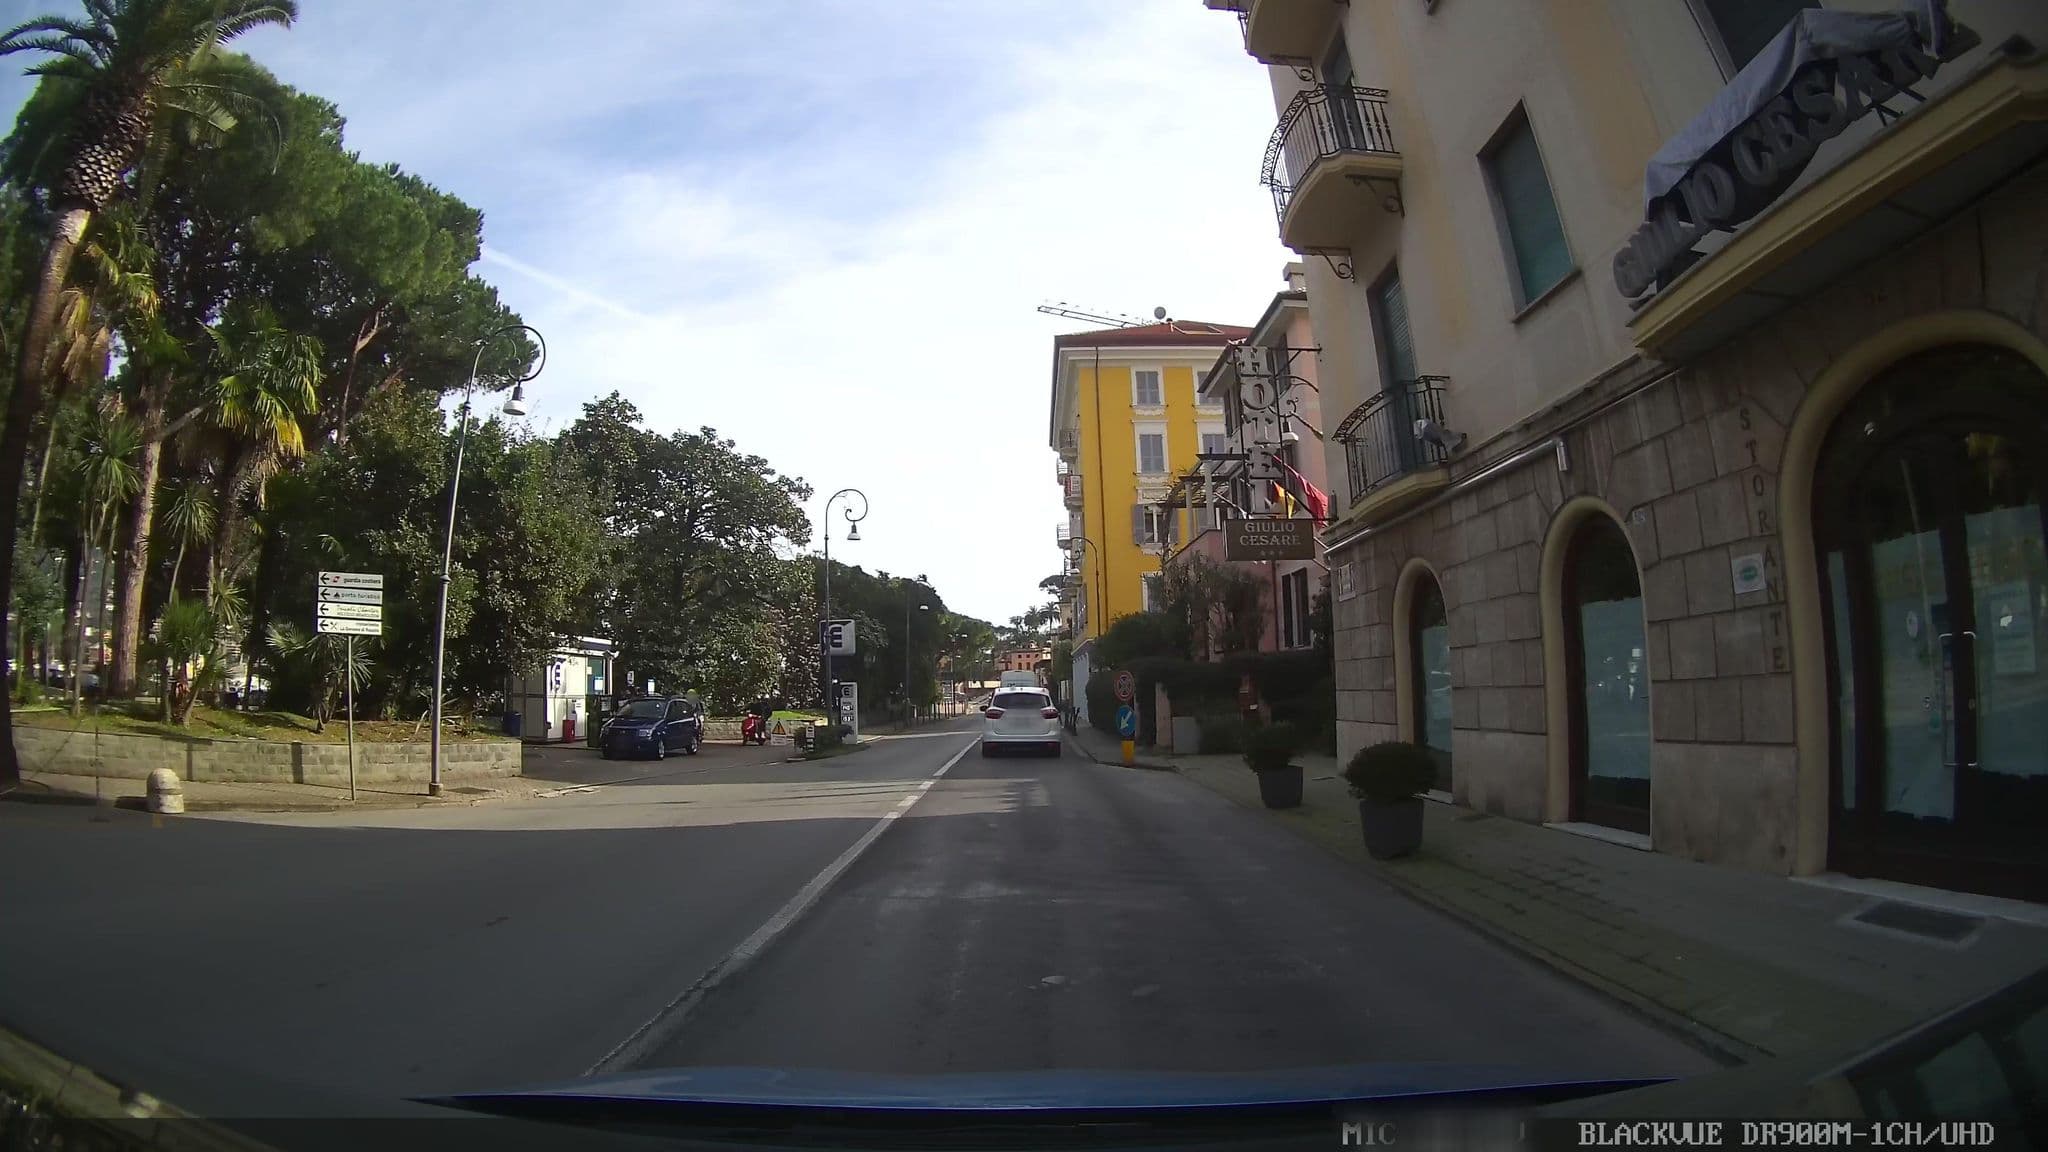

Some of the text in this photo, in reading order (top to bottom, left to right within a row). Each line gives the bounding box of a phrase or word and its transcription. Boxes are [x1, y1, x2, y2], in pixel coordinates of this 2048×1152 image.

[1236, 347, 1287, 514] HOTEL
[1244, 521, 1295, 533] GIULIO
[1239, 534, 1302, 546] CESARE
